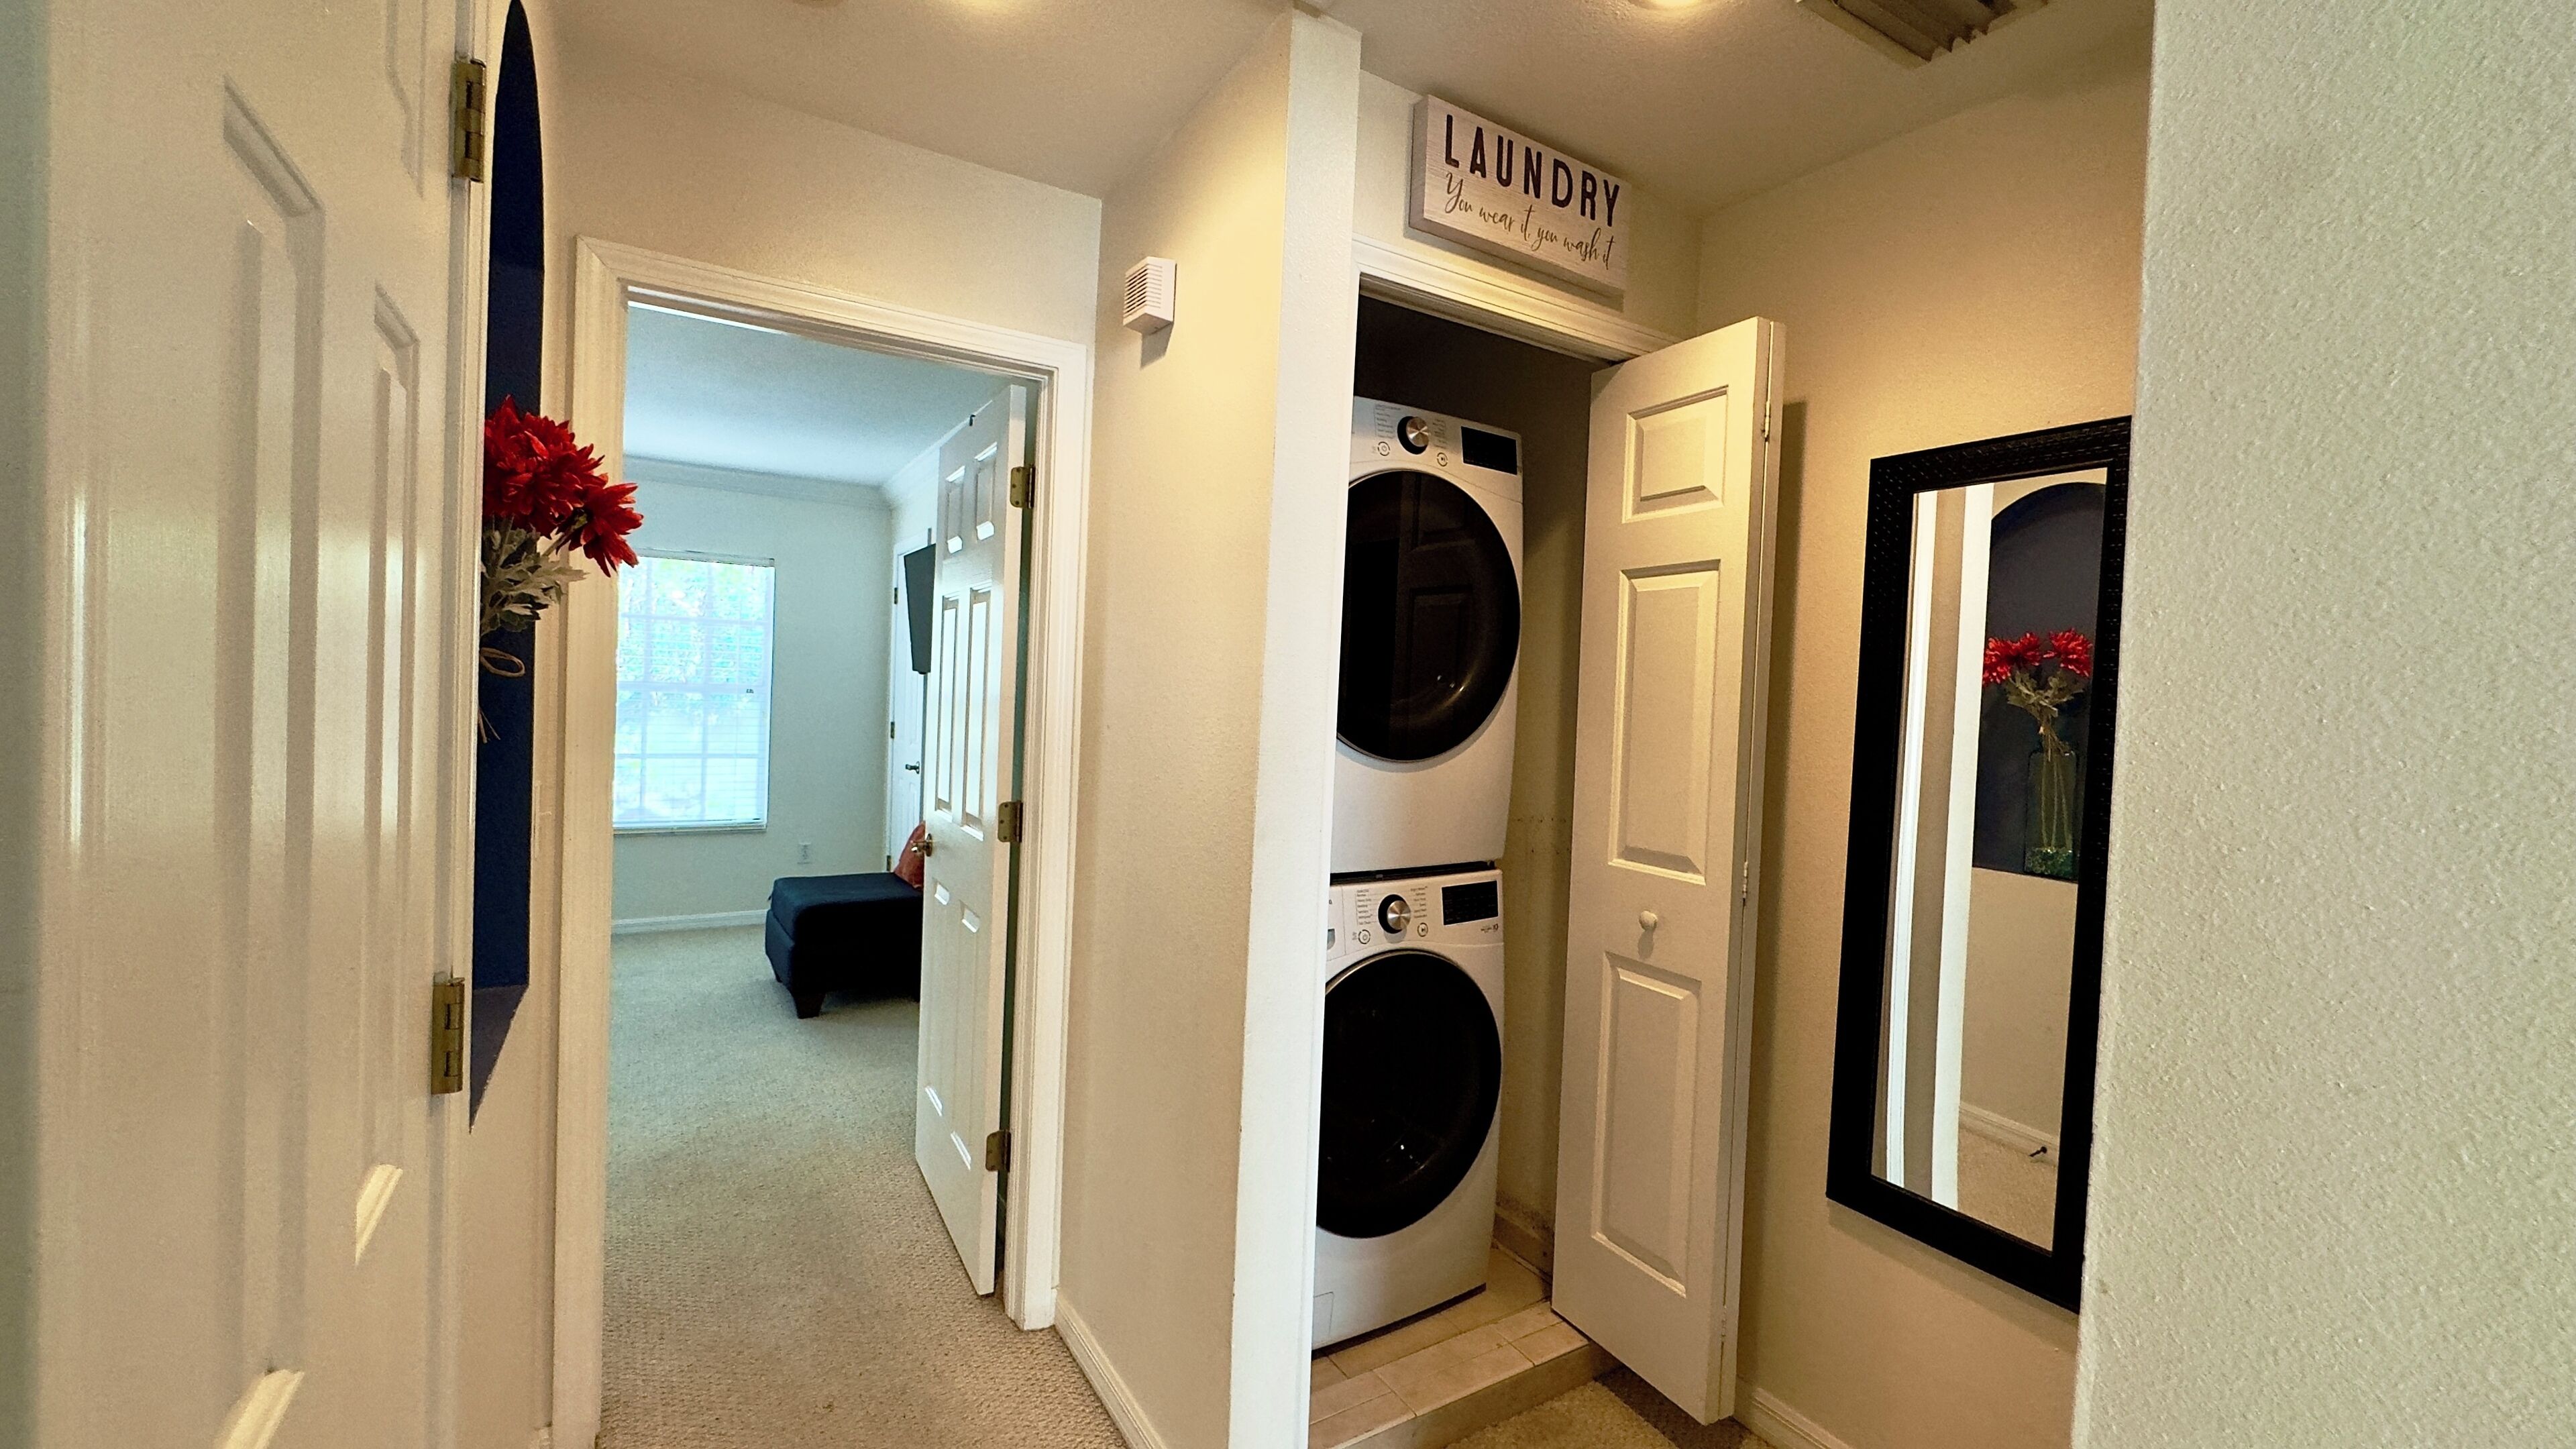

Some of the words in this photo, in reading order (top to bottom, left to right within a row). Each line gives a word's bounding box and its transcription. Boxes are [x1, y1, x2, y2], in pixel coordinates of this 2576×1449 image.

[1444, 172, 1473, 214] You
[1479, 207, 1515, 232] wear
[1531, 227, 1558, 252] you
[1563, 227, 1602, 262] wash
[1603, 235, 1616, 270] it
[1445, 114, 1620, 227] LAUNDRY
